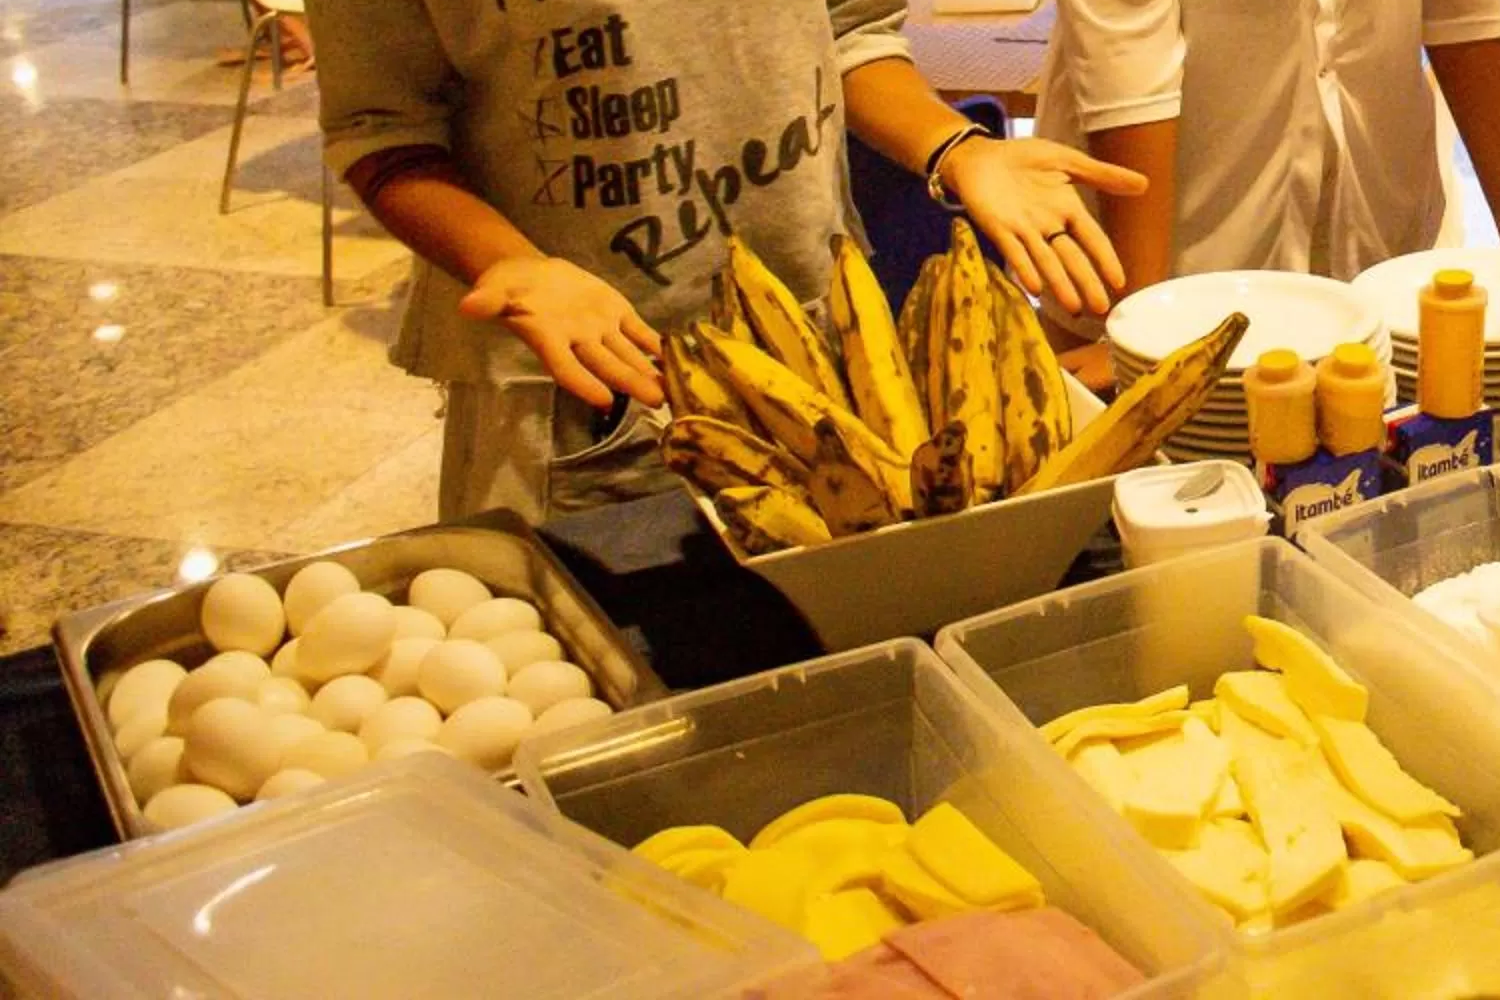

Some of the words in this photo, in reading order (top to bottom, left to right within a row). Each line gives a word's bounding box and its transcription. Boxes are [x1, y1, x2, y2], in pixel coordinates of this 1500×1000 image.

[550, 12, 632, 80] Eat
[565, 76, 682, 141] Sleep
[571, 138, 696, 211] Party
[609, 65, 837, 287] Repeat
